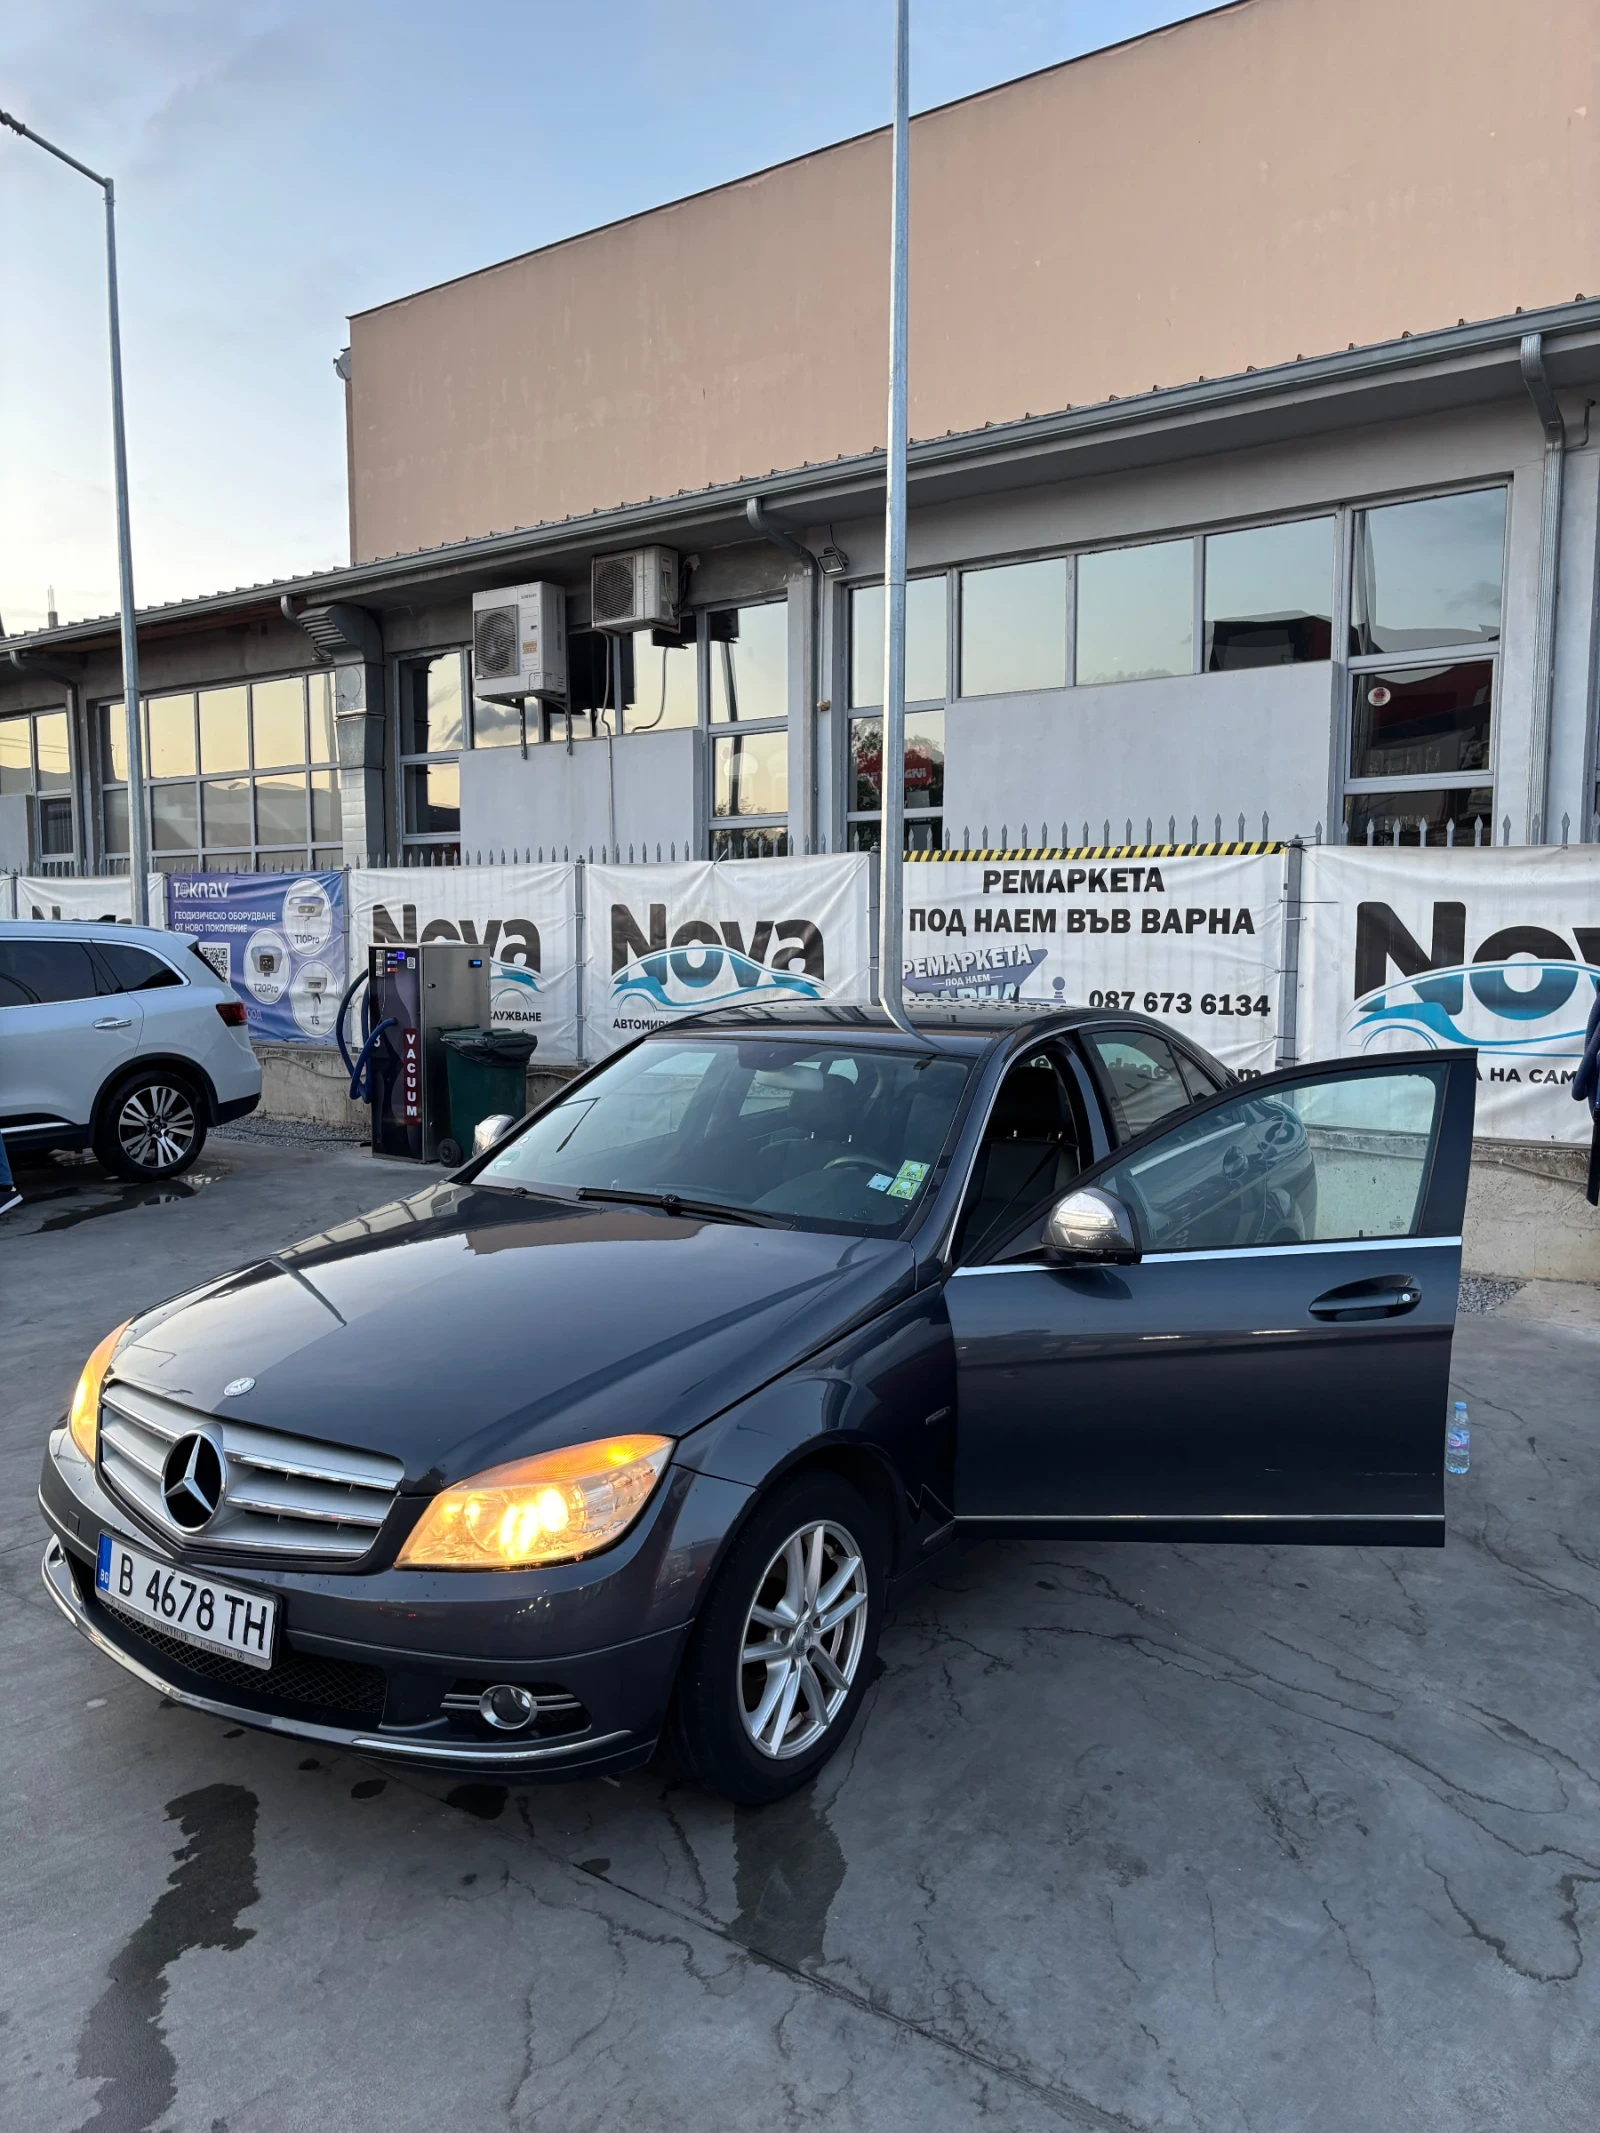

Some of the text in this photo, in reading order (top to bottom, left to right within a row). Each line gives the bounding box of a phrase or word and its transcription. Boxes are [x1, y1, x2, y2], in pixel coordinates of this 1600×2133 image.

[982, 867, 1165, 894] РЕМАРКЕТА
[174, 923, 248, 933] ОТ НОВО ПОКОЛЕНИЕ
[227, 912, 276, 922] ОБОРУДВАНЕ
[909, 908, 1256, 937] ПОД НАЕМ ВЪВ ВАРНА
[611, 903, 825, 988] Nova
[902, 944, 1035, 980] РЕМАРКЕТА
[1354, 901, 1600, 1021] No
[253, 983, 279, 994] T20Pro
[945, 973, 991, 987] ПОД НАЕМ
[1088, 990, 1271, 1017] 087 673 6134
[490, 1010, 542, 1022] ЛУЖВАНЕ
[613, 1018, 672, 1031] АВТОМИ
[406, 1033, 418, 1117] VACUUM
[1490, 1067, 1522, 1083] НА
[1528, 1069, 1579, 1085] САМ
[100, 1569, 109, 1584] BG
[118, 1552, 268, 1650] B 4678 TH
